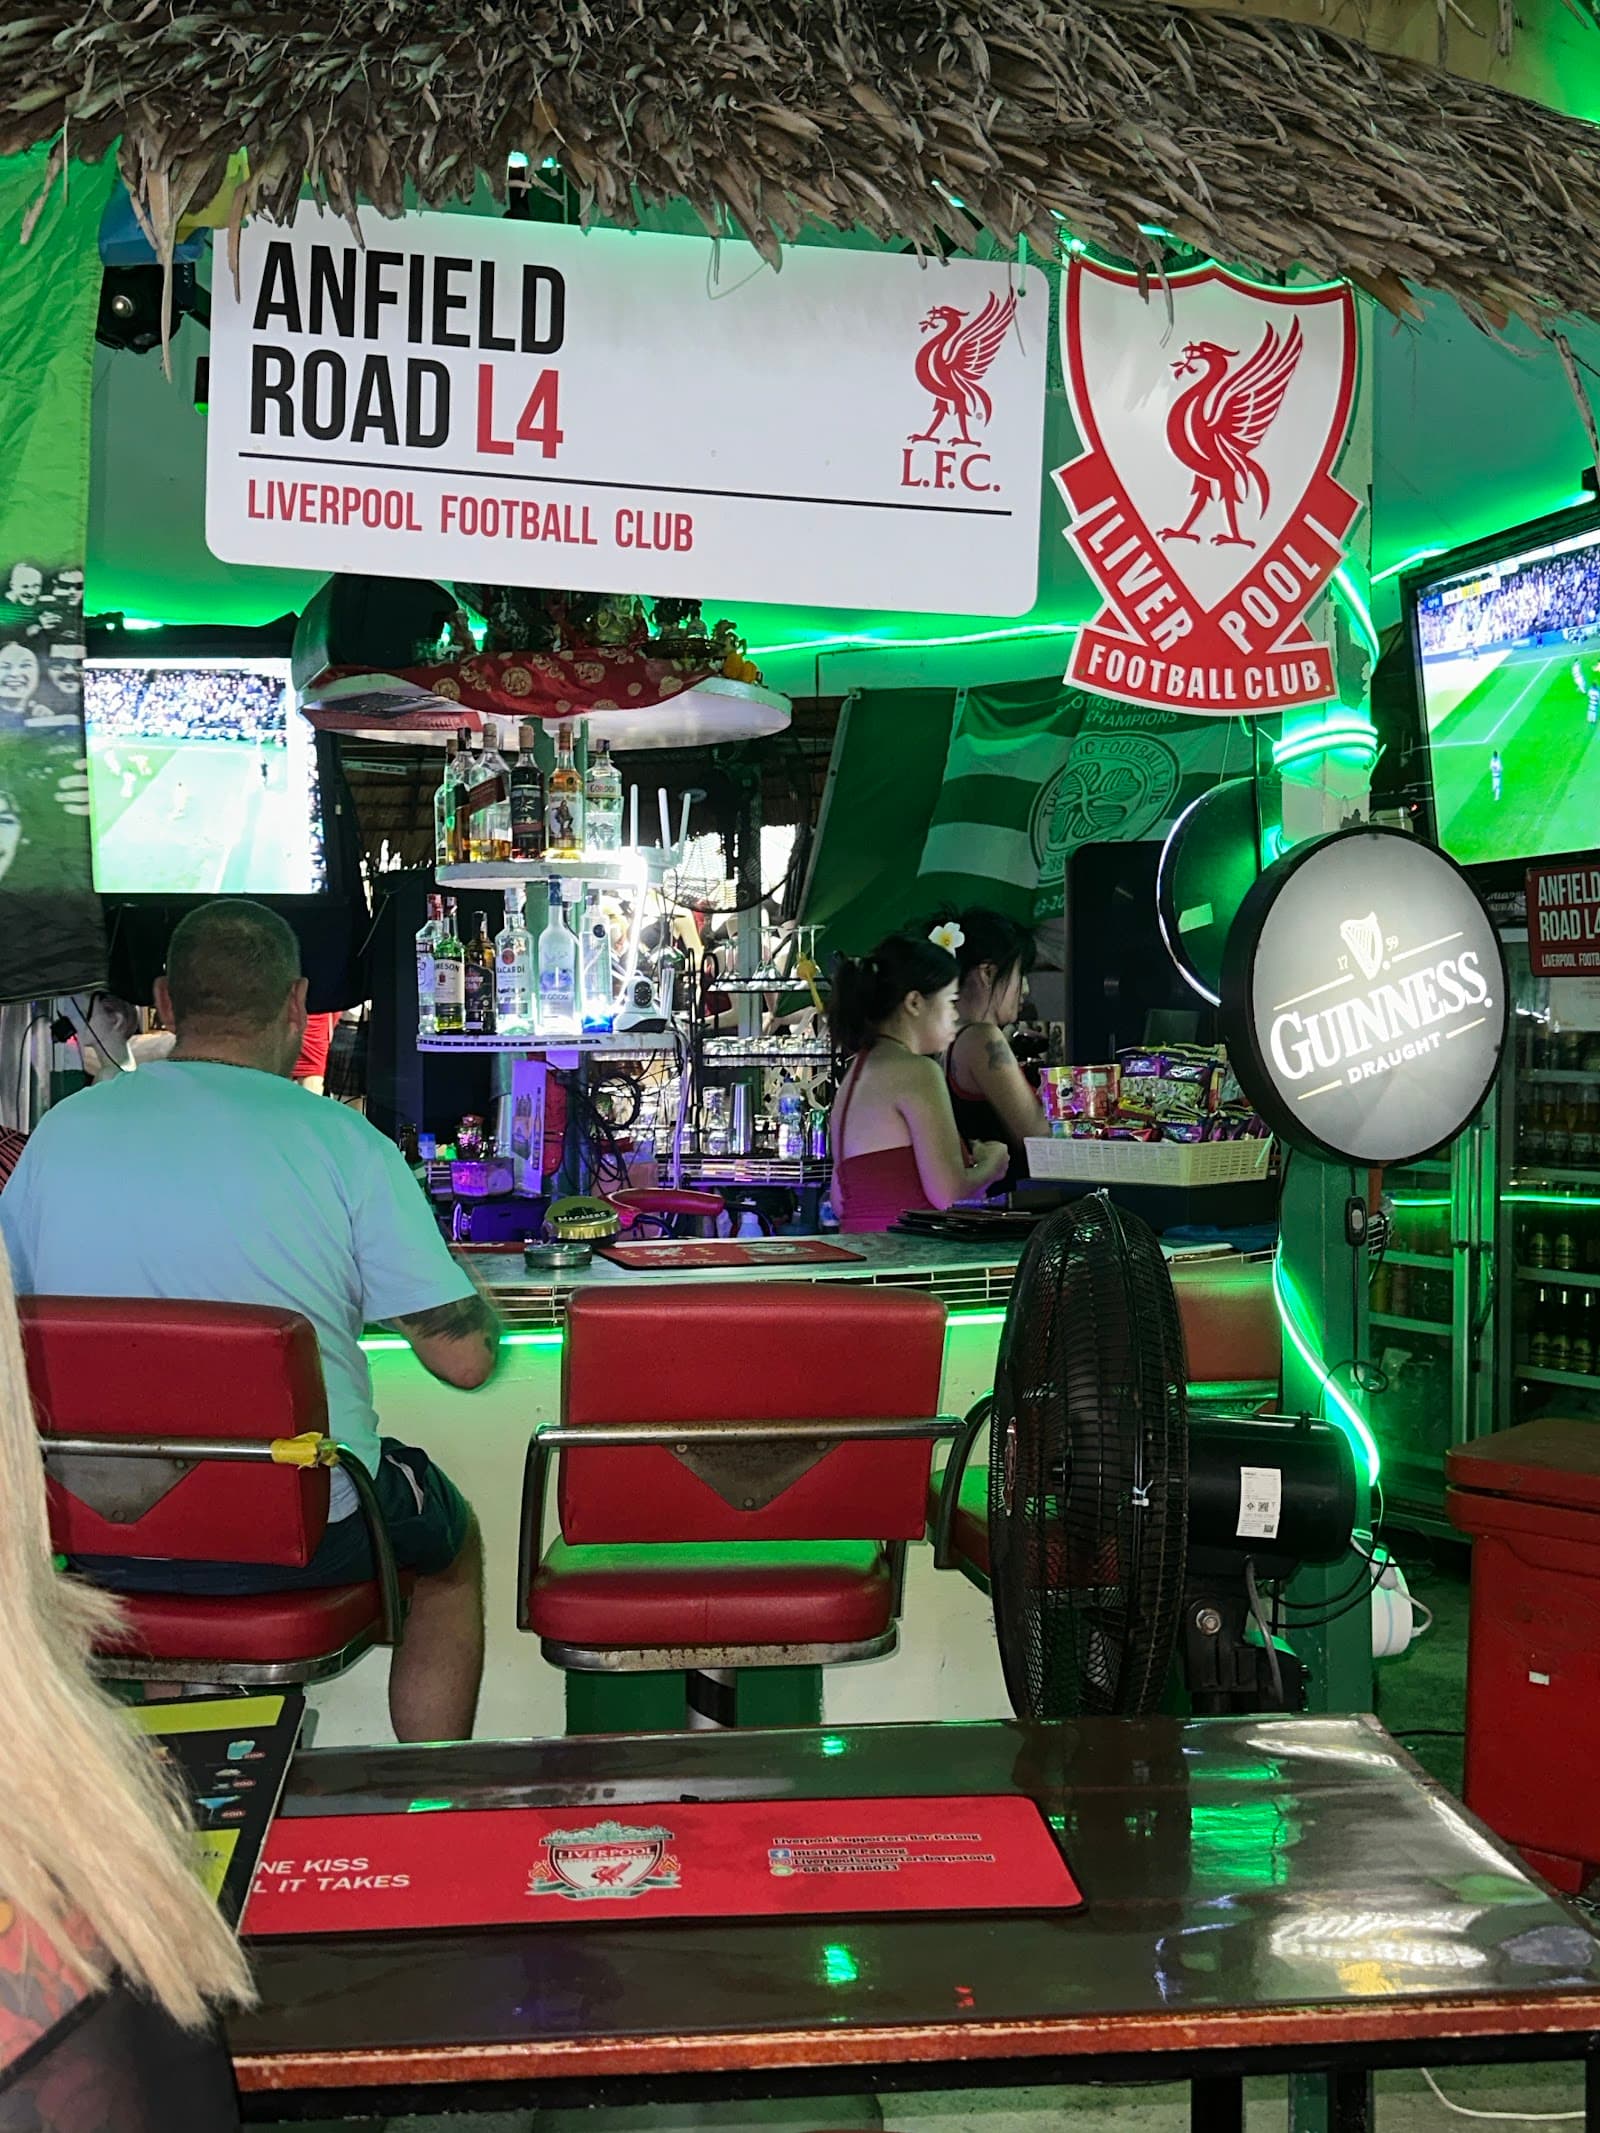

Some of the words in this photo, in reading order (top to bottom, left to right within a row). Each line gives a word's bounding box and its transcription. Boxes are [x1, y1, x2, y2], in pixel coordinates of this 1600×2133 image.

[252, 240, 566, 355] ANFIELD
[250, 345, 451, 448] ROAD
[476, 364, 564, 459] L4
[901, 448, 1001, 492] L.F.C.
[247, 479, 422, 532] LIVERPOOL
[440, 495, 598, 546] FOOTBALL
[614, 509, 694, 553] CLUB
[1088, 513, 1193, 652] LIVER
[1219, 543, 1320, 655] POOL
[1087, 644, 1236, 700] FOOTBALL
[1246, 660, 1320, 699] CLUB
[1086, 710, 1178, 727] CHAMPIONS
[1100, 741, 1168, 771] FOOTBALL
[1538, 871, 1600, 907] ANFIELD
[1539, 909, 1582, 942] ROAD
[1542, 952, 1577, 968] LIVERPOOL
[1270, 951, 1488, 1080] GUINNESS
[1347, 1031, 1441, 1084] DRAUGHT
[558, 1847, 651, 1859] LIVERPOOL
[774, 1836, 833, 1847] Liverpool
[836, 1834, 906, 1845] Supporters
[934, 1833, 981, 1842] Patong
[860, 1847, 908, 1857] Patong
[256, 1859, 296, 1875] NE
[303, 1857, 369, 1874] KISS
[278, 1877, 308, 1893] IT
[317, 1873, 411, 1892] TAKES
